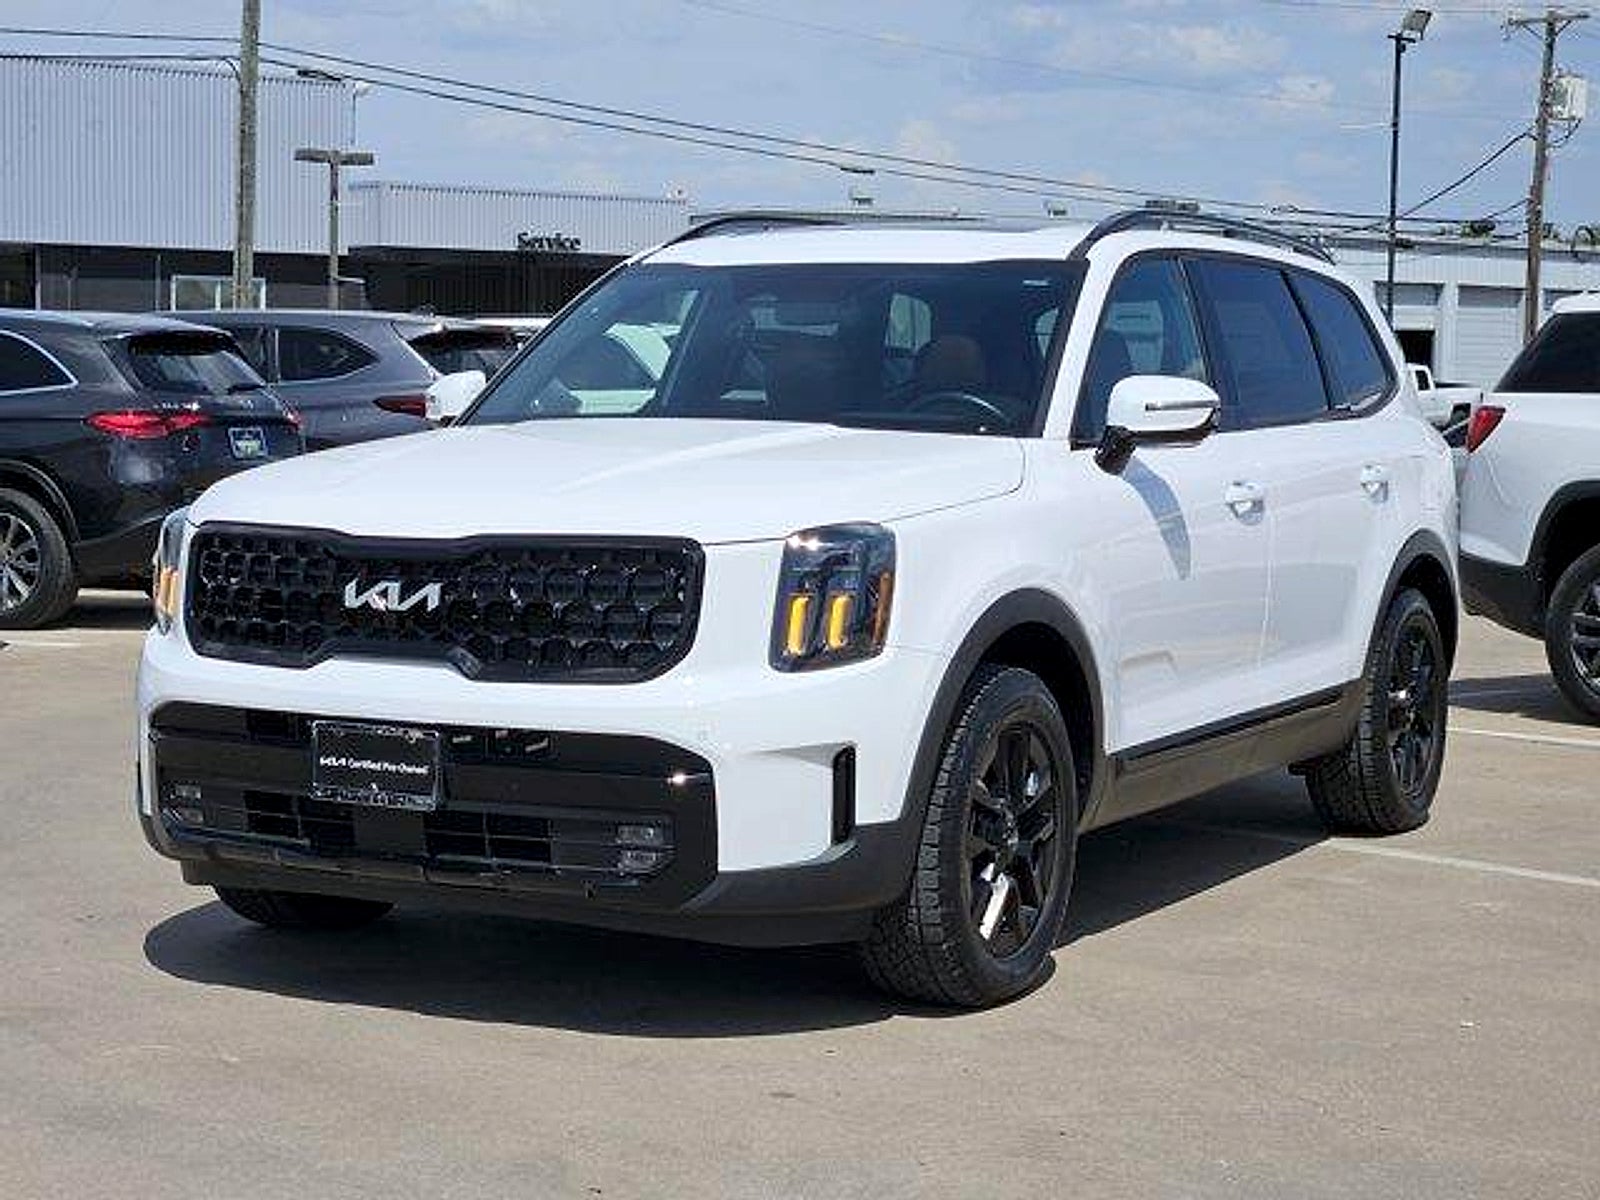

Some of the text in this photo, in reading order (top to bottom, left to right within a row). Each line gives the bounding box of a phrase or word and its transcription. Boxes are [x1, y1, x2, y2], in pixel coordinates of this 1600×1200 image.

[517, 232, 581, 251] Service
[345, 577, 442, 611] KIA
[320, 757, 346, 767] KIA
[347, 758, 381, 771] Certified
